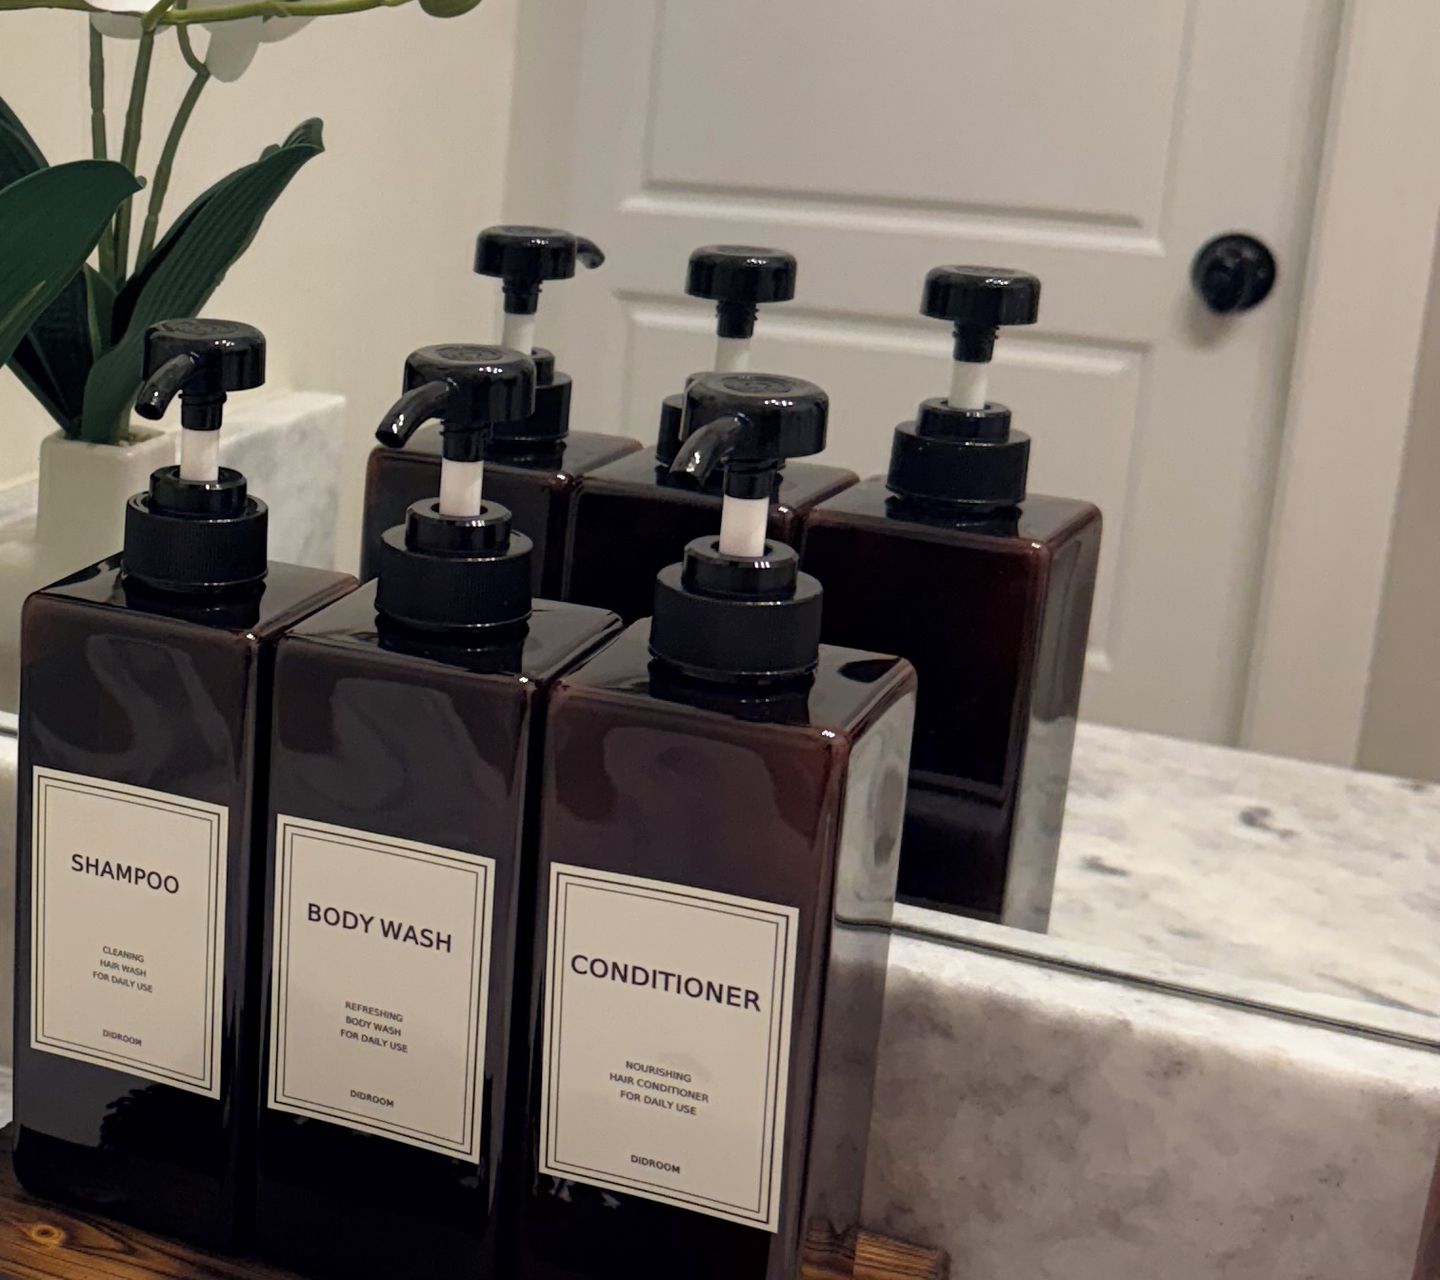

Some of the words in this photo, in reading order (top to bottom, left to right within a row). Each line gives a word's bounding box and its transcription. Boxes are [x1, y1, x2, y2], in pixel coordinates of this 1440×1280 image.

[71, 853, 180, 894] SHAMPOO
[308, 902, 375, 934] BODY
[379, 918, 452, 953] WASH
[102, 945, 145, 963] CLEANING
[100, 959, 121, 971] HAIR
[122, 964, 147, 978] WASH
[92, 970, 110, 982] FOR
[111, 974, 136, 988] DAILY
[137, 982, 153, 993] USE
[571, 954, 761, 1012] CONDITIONER
[345, 1001, 403, 1023] REFRESHING
[345, 1016, 372, 1029] BODY
[373, 1022, 402, 1036] WASH
[340, 1028, 359, 1041] FOR
[361, 1033, 388, 1048] DAILY
[389, 1041, 408, 1053] USE
[625, 1060, 692, 1084] NOURISHING
[350, 1089, 394, 1108] DIDROOM
[609, 1072, 635, 1087] HAIR
[637, 1079, 709, 1103] CONDITIONER
[620, 1090, 642, 1103] FOR
[643, 1096, 674, 1111] DAILY
[676, 1104, 697, 1115] USE
[630, 1154, 681, 1175] DIDROOM
